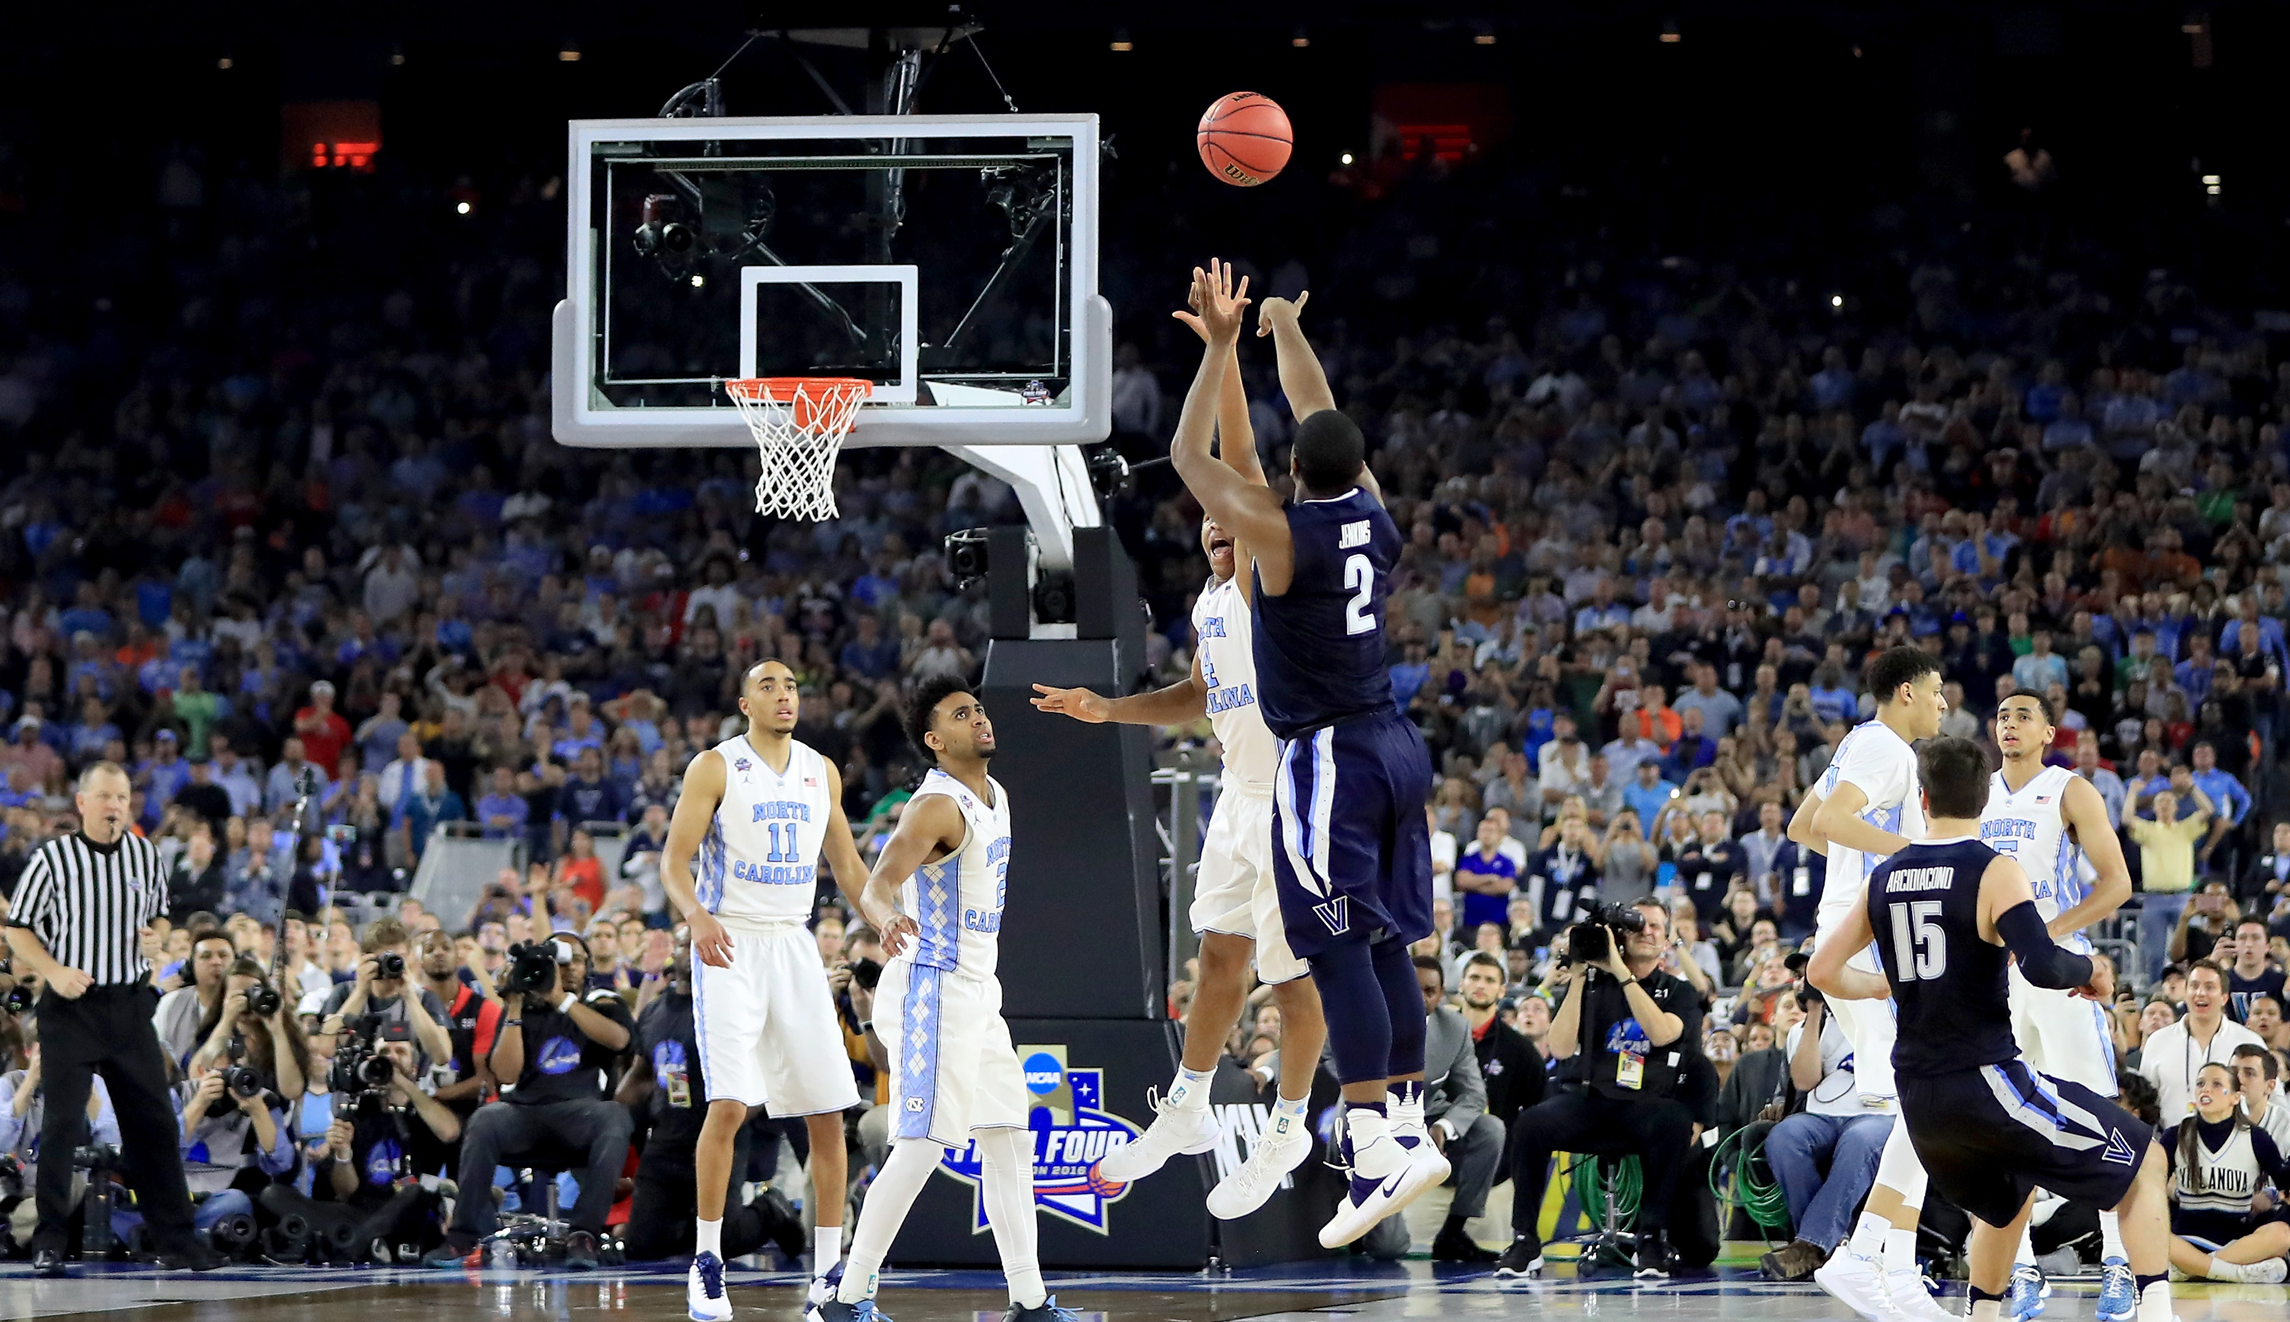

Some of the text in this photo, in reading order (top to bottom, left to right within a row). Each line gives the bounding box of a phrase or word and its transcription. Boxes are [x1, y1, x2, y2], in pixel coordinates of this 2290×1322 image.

[1338, 519, 1371, 549] JENKINS
[1344, 553, 1377, 635] 2
[1205, 683, 1255, 714] LINA
[752, 801, 811, 823] NORTH
[767, 822, 800, 863] 11
[1979, 818, 2037, 840] NORTH
[1885, 866, 1955, 894] ARCIDIACONO
[1888, 900, 1947, 982] 15
[1654, 988, 1669, 998] 21
[1026, 1071, 1062, 1085] NCAA
[1044, 1130, 1129, 1164] FOUR
[1051, 1165, 1088, 1176] 2016
[2179, 1166, 2248, 1193] VILANOVA
